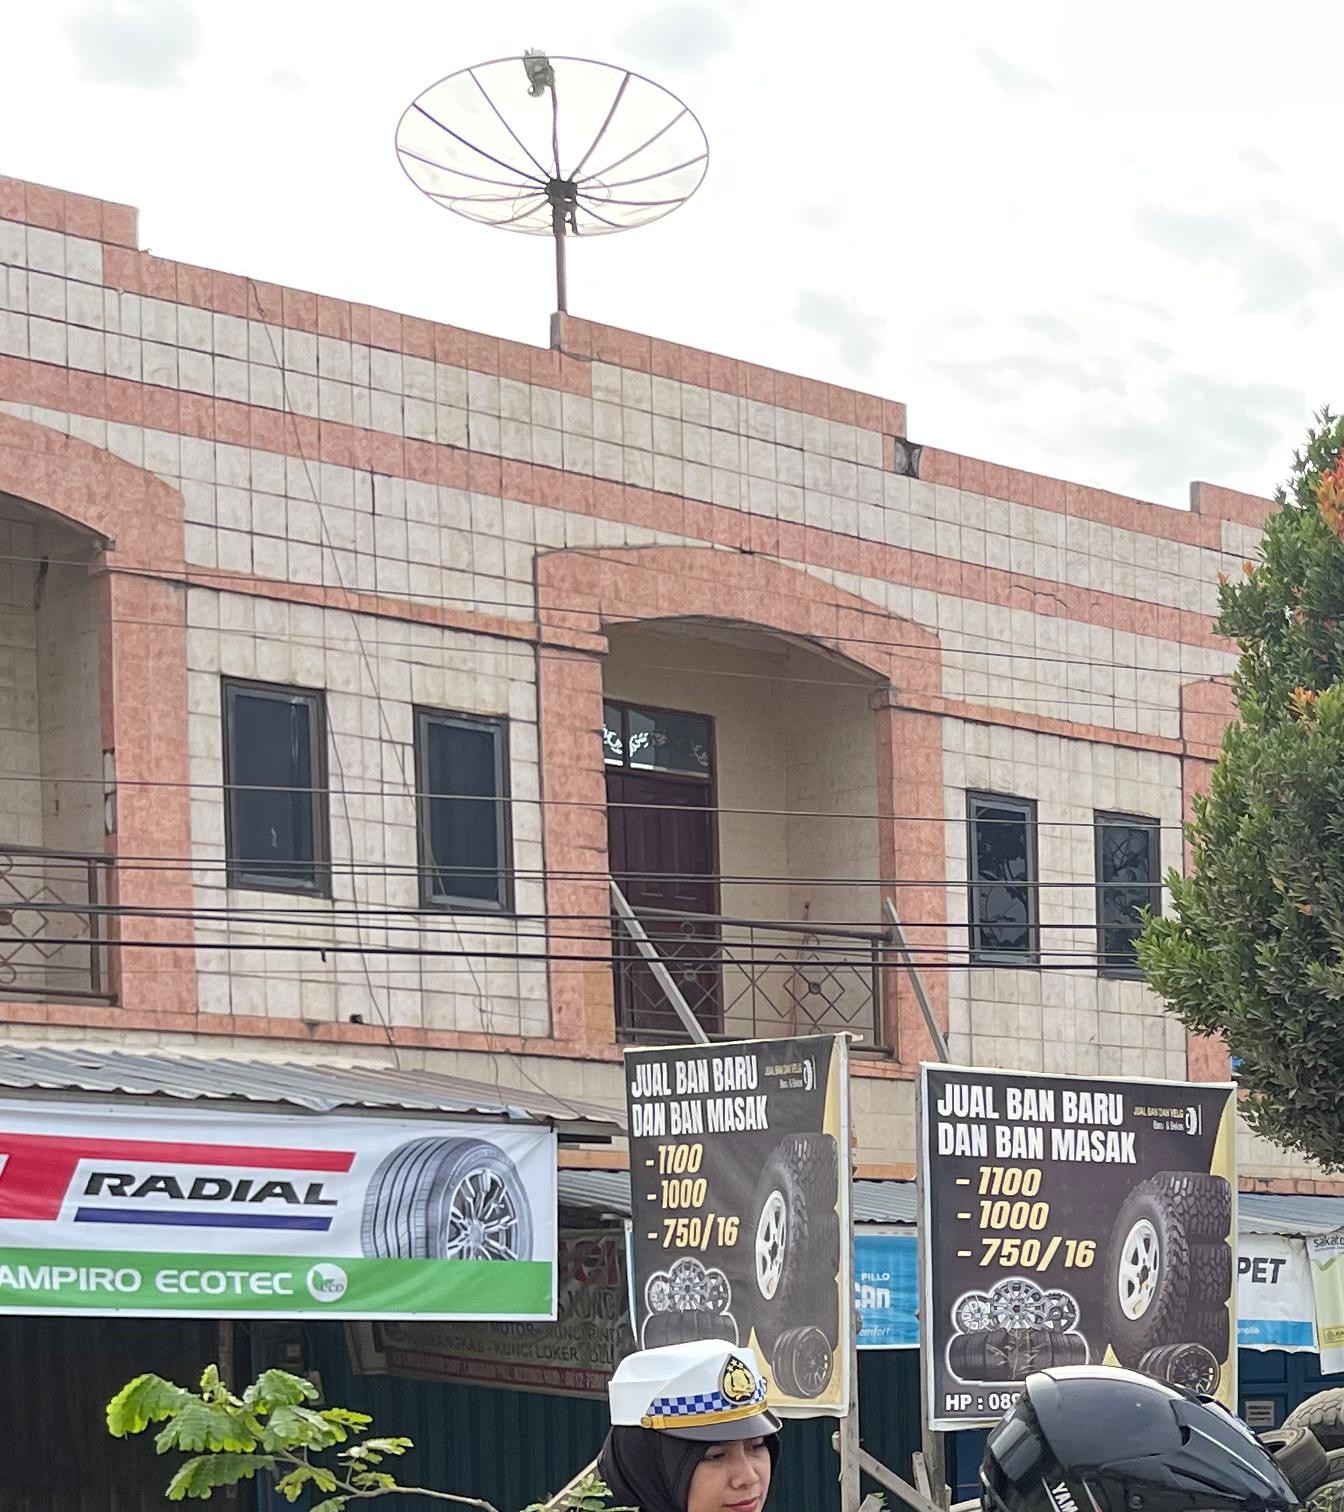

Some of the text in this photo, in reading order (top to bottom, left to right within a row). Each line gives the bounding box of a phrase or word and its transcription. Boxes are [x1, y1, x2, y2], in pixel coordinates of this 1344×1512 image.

[631, 1063, 671, 1097] JUAL
[675, 1059, 709, 1094] BAN
[712, 1055, 758, 1092] BARU
[632, 1095, 768, 1137] DAN BAN MASAK
[937, 1083, 1123, 1126] JUAL BAN BARU
[658, 1143, 703, 1175] 1100
[938, 1122, 1136, 1164] DAN BAN MASAK
[84, 1172, 338, 1206] RADIAL
[661, 1178, 707, 1209] 1000
[978, 1166, 1042, 1197] 1100
[979, 1200, 1049, 1230] 1000
[662, 1213, 740, 1251] 750/16
[979, 1237, 1096, 1272] 750/16
[1238, 1256, 1286, 1285] PET
[0, 1264, 294, 1296] AMPIRO ECOTEC
[861, 1272, 891, 1281] PILLO
[945, 1394, 972, 1411] HP
